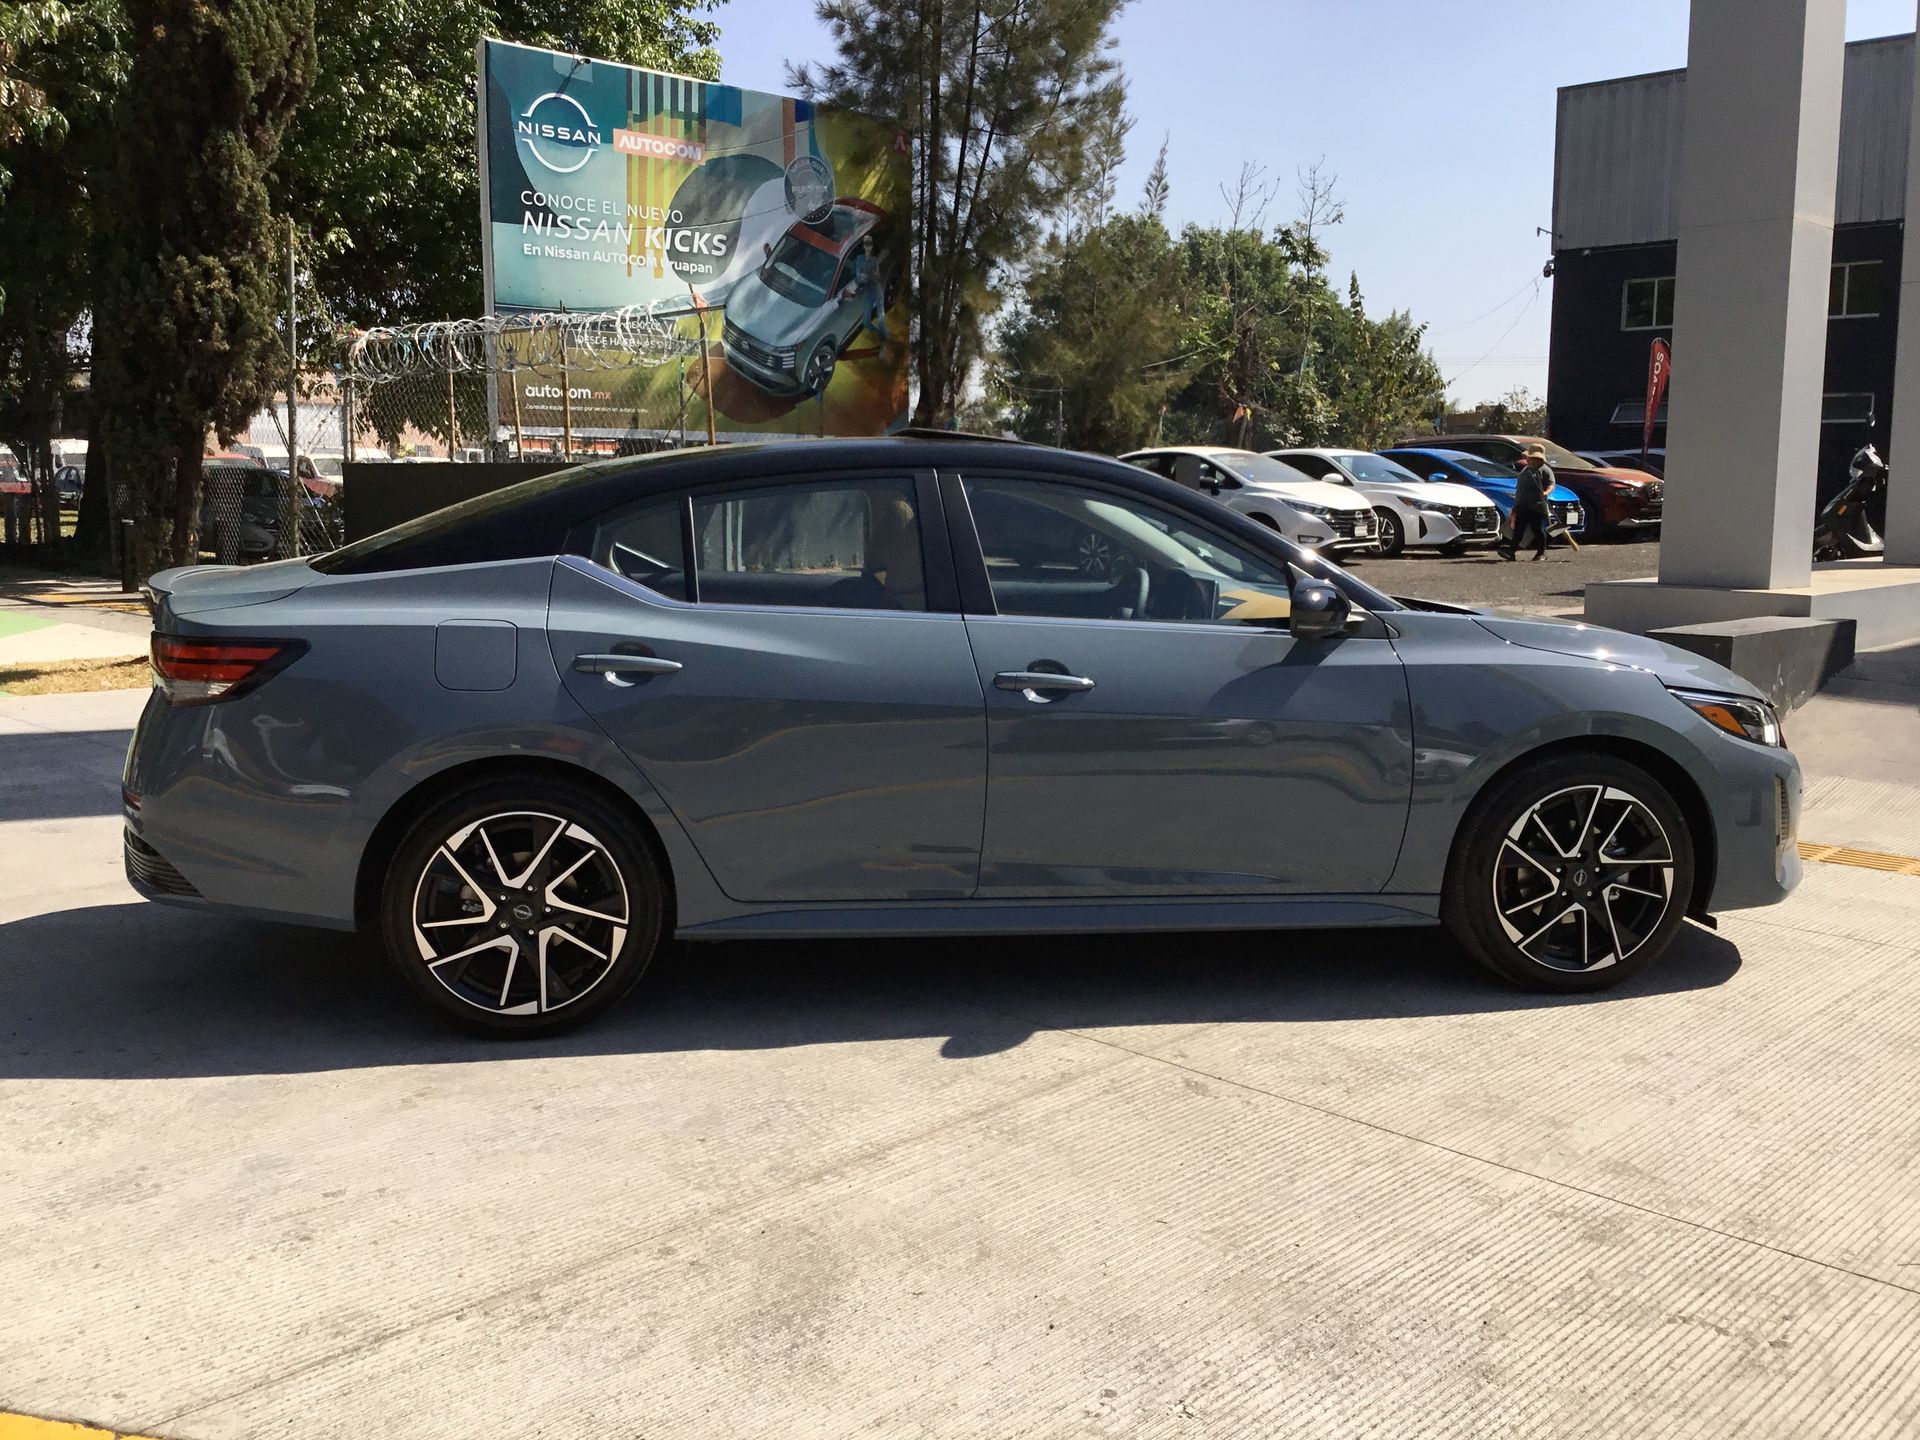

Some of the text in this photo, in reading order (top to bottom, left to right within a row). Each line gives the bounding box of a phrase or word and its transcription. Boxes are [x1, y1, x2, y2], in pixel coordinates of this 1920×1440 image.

[518, 121, 600, 144] NISSAN
[619, 135, 701, 160] AUTOCOM
[520, 190, 683, 224] CONOCE EL NUEVO
[522, 210, 728, 257] NISSAN KICKS
[523, 243, 541, 256] En
[544, 245, 590, 261] Nissan
[593, 251, 658, 268] AUTOCOM
[525, 384, 611, 400] autoom.mx
